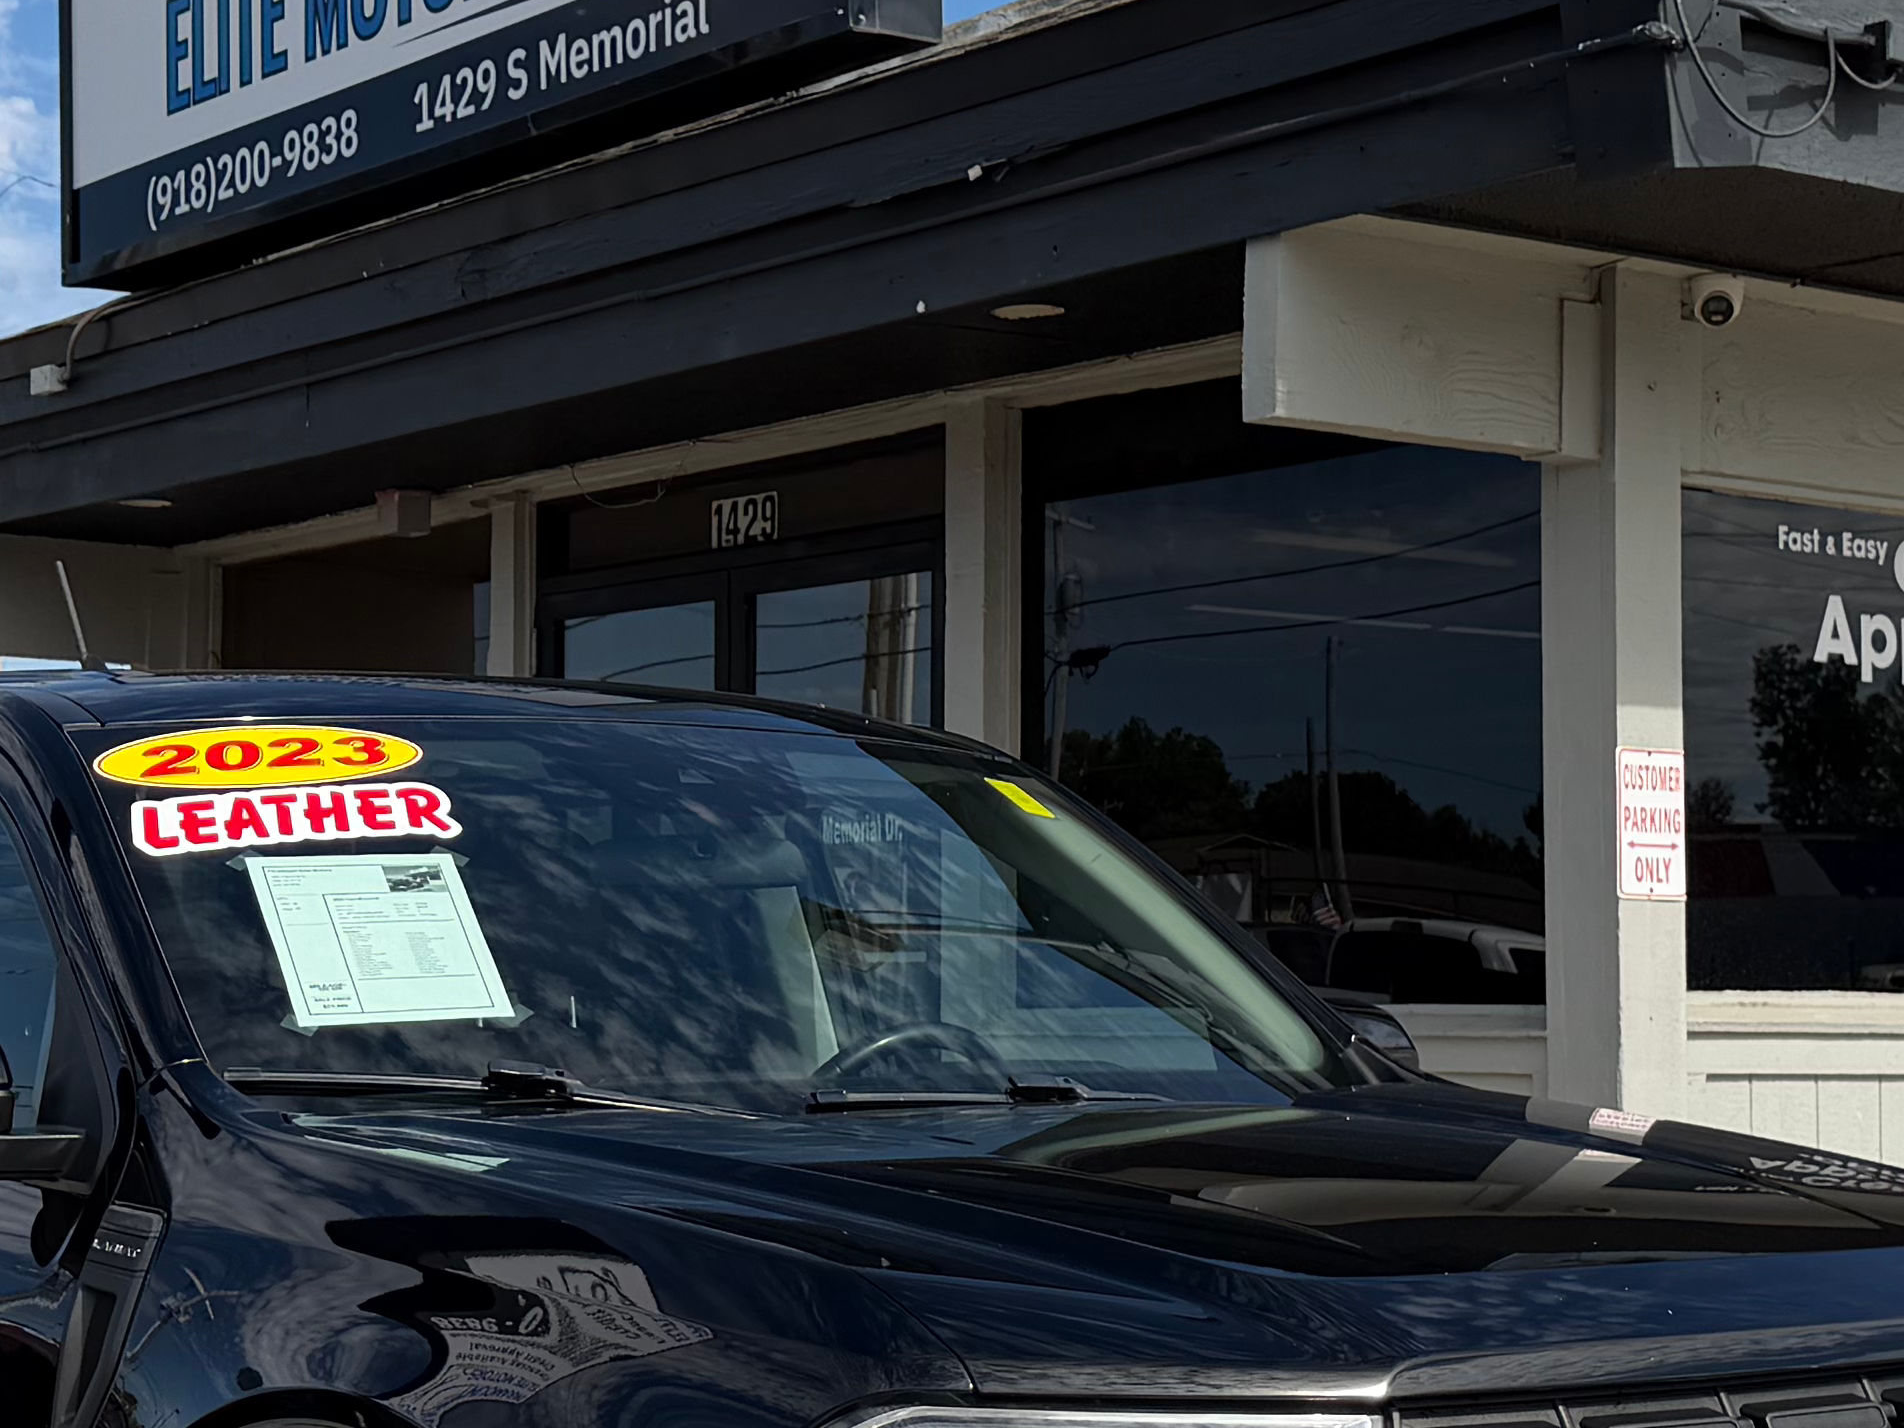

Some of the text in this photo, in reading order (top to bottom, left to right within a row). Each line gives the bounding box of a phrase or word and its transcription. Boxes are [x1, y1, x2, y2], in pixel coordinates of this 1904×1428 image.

[413, 73, 497, 134] 1429
[507, 53, 528, 101] S
[146, 108, 360, 232] (918)200-9838
[714, 494, 777, 548] 1429
[1777, 524, 1820, 555] Fast
[1825, 535, 1836, 556] &
[1842, 530, 1889, 566] Easy
[140, 737, 390, 778] 2023
[1623, 764, 1681, 792] CUSTOMER
[142, 787, 452, 849] LEATHER
[822, 815, 881, 844] Memorial
[1623, 805, 1681, 834] PARKING
[1634, 856, 1672, 885] ONLY
